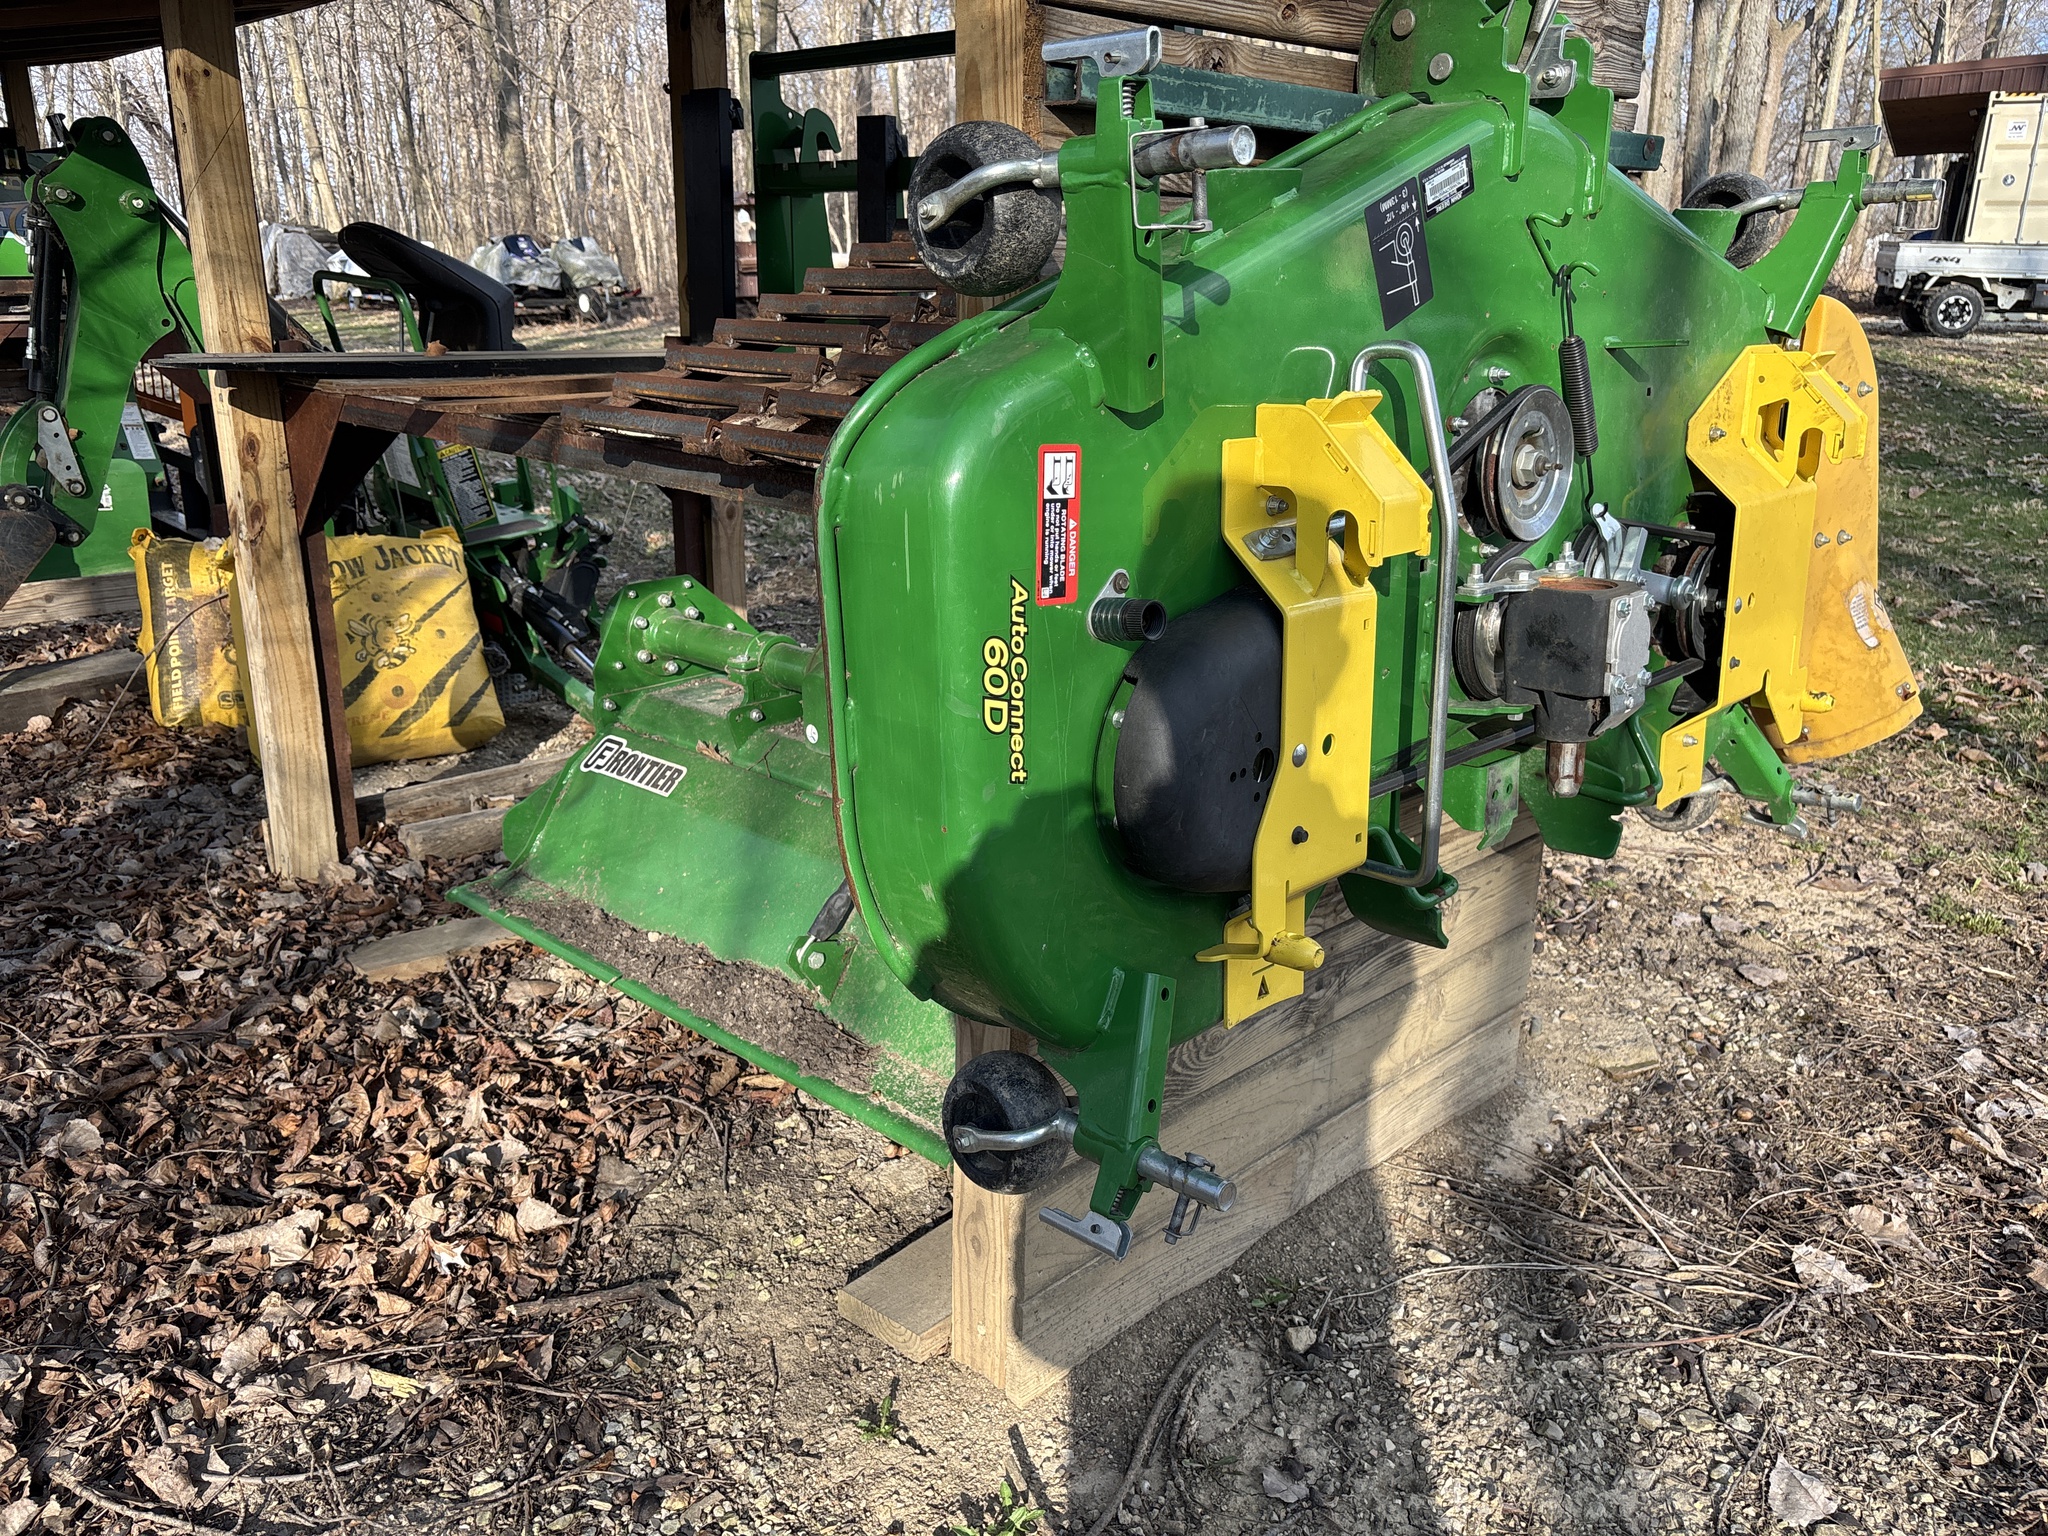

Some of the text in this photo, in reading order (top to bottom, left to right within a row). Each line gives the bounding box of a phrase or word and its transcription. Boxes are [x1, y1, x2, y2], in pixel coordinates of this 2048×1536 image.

[1055, 502, 1061, 513] Do
[374, 545, 462, 575] JACKET
[1068, 531, 1077, 577] DANGER
[161, 562, 177, 616] TARGET
[171, 668, 184, 711] FIELD
[982, 635, 1009, 734] 60D
[1010, 575, 1029, 784] AutoConnect
[583, 738, 684, 793] FRONTIER
